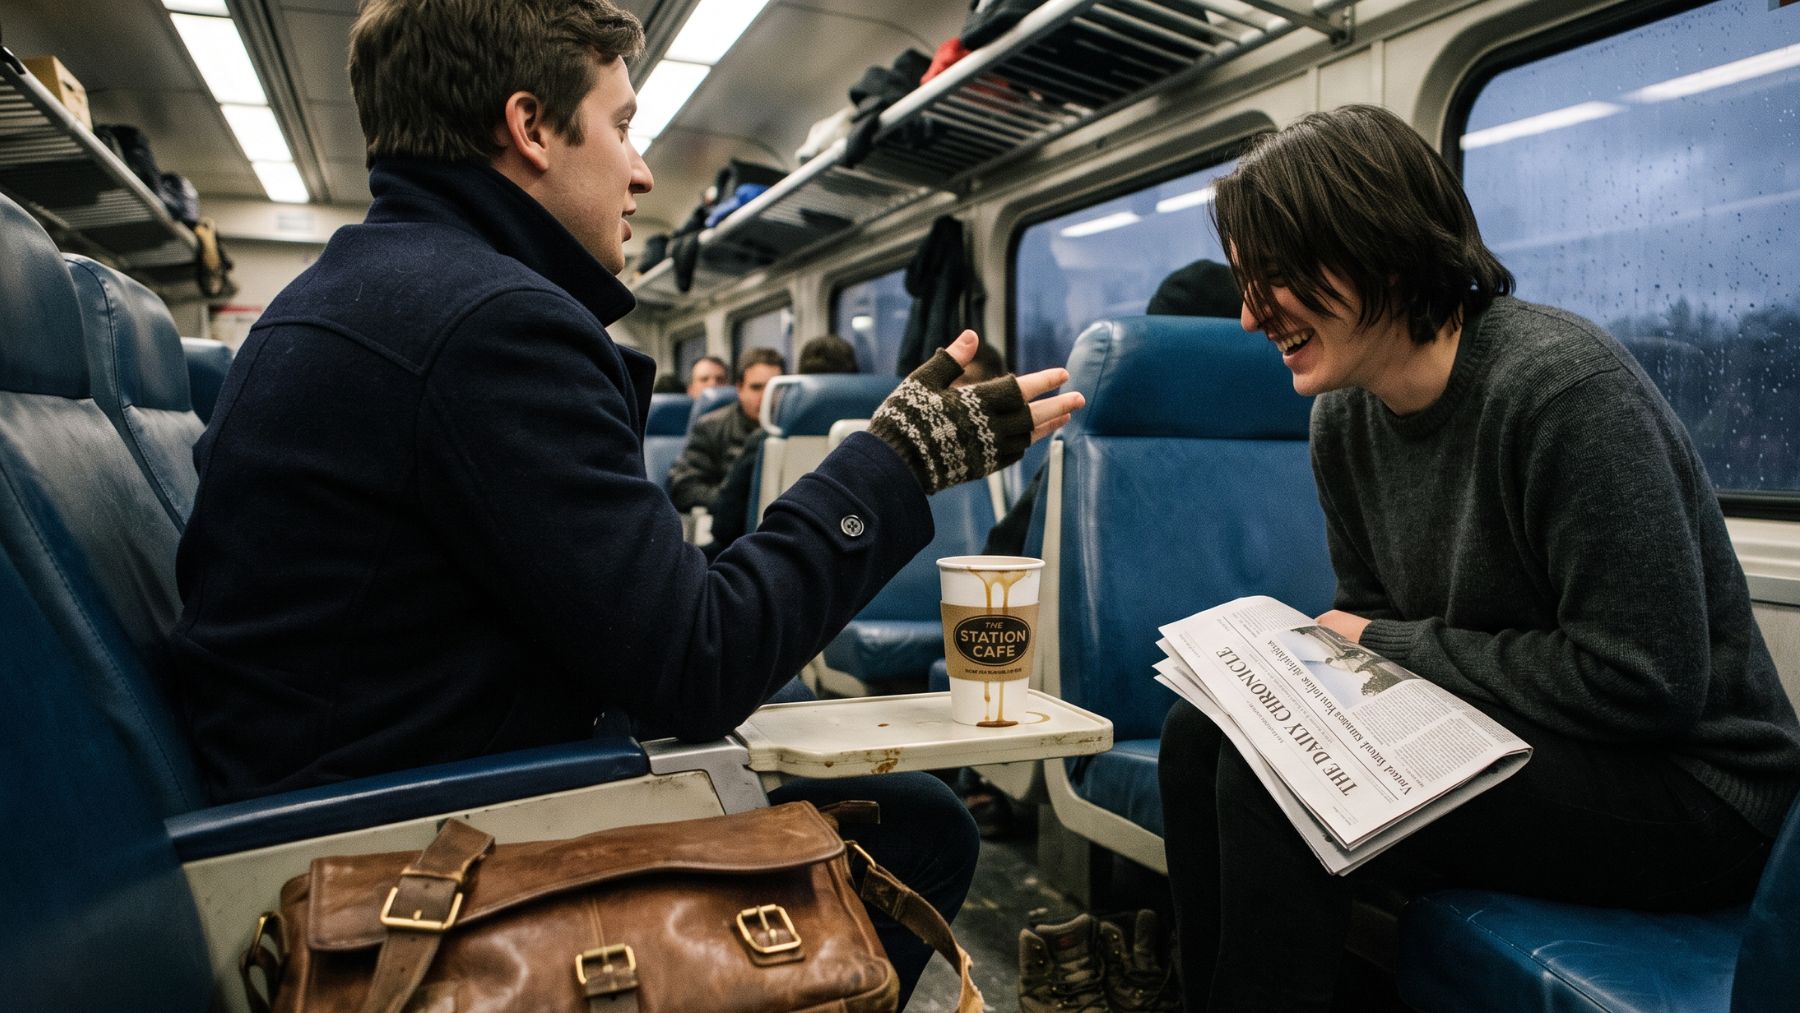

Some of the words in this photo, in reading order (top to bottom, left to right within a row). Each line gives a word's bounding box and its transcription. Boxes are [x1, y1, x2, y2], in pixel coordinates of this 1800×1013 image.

[961, 630, 1026, 643] STATION
[985, 621, 1003, 629] THE
[973, 644, 1016, 658] CAFE
[1215, 646, 1291, 722] CHRONICLE
[1284, 722, 1332, 766] DAILY
[1323, 762, 1358, 797] THE
